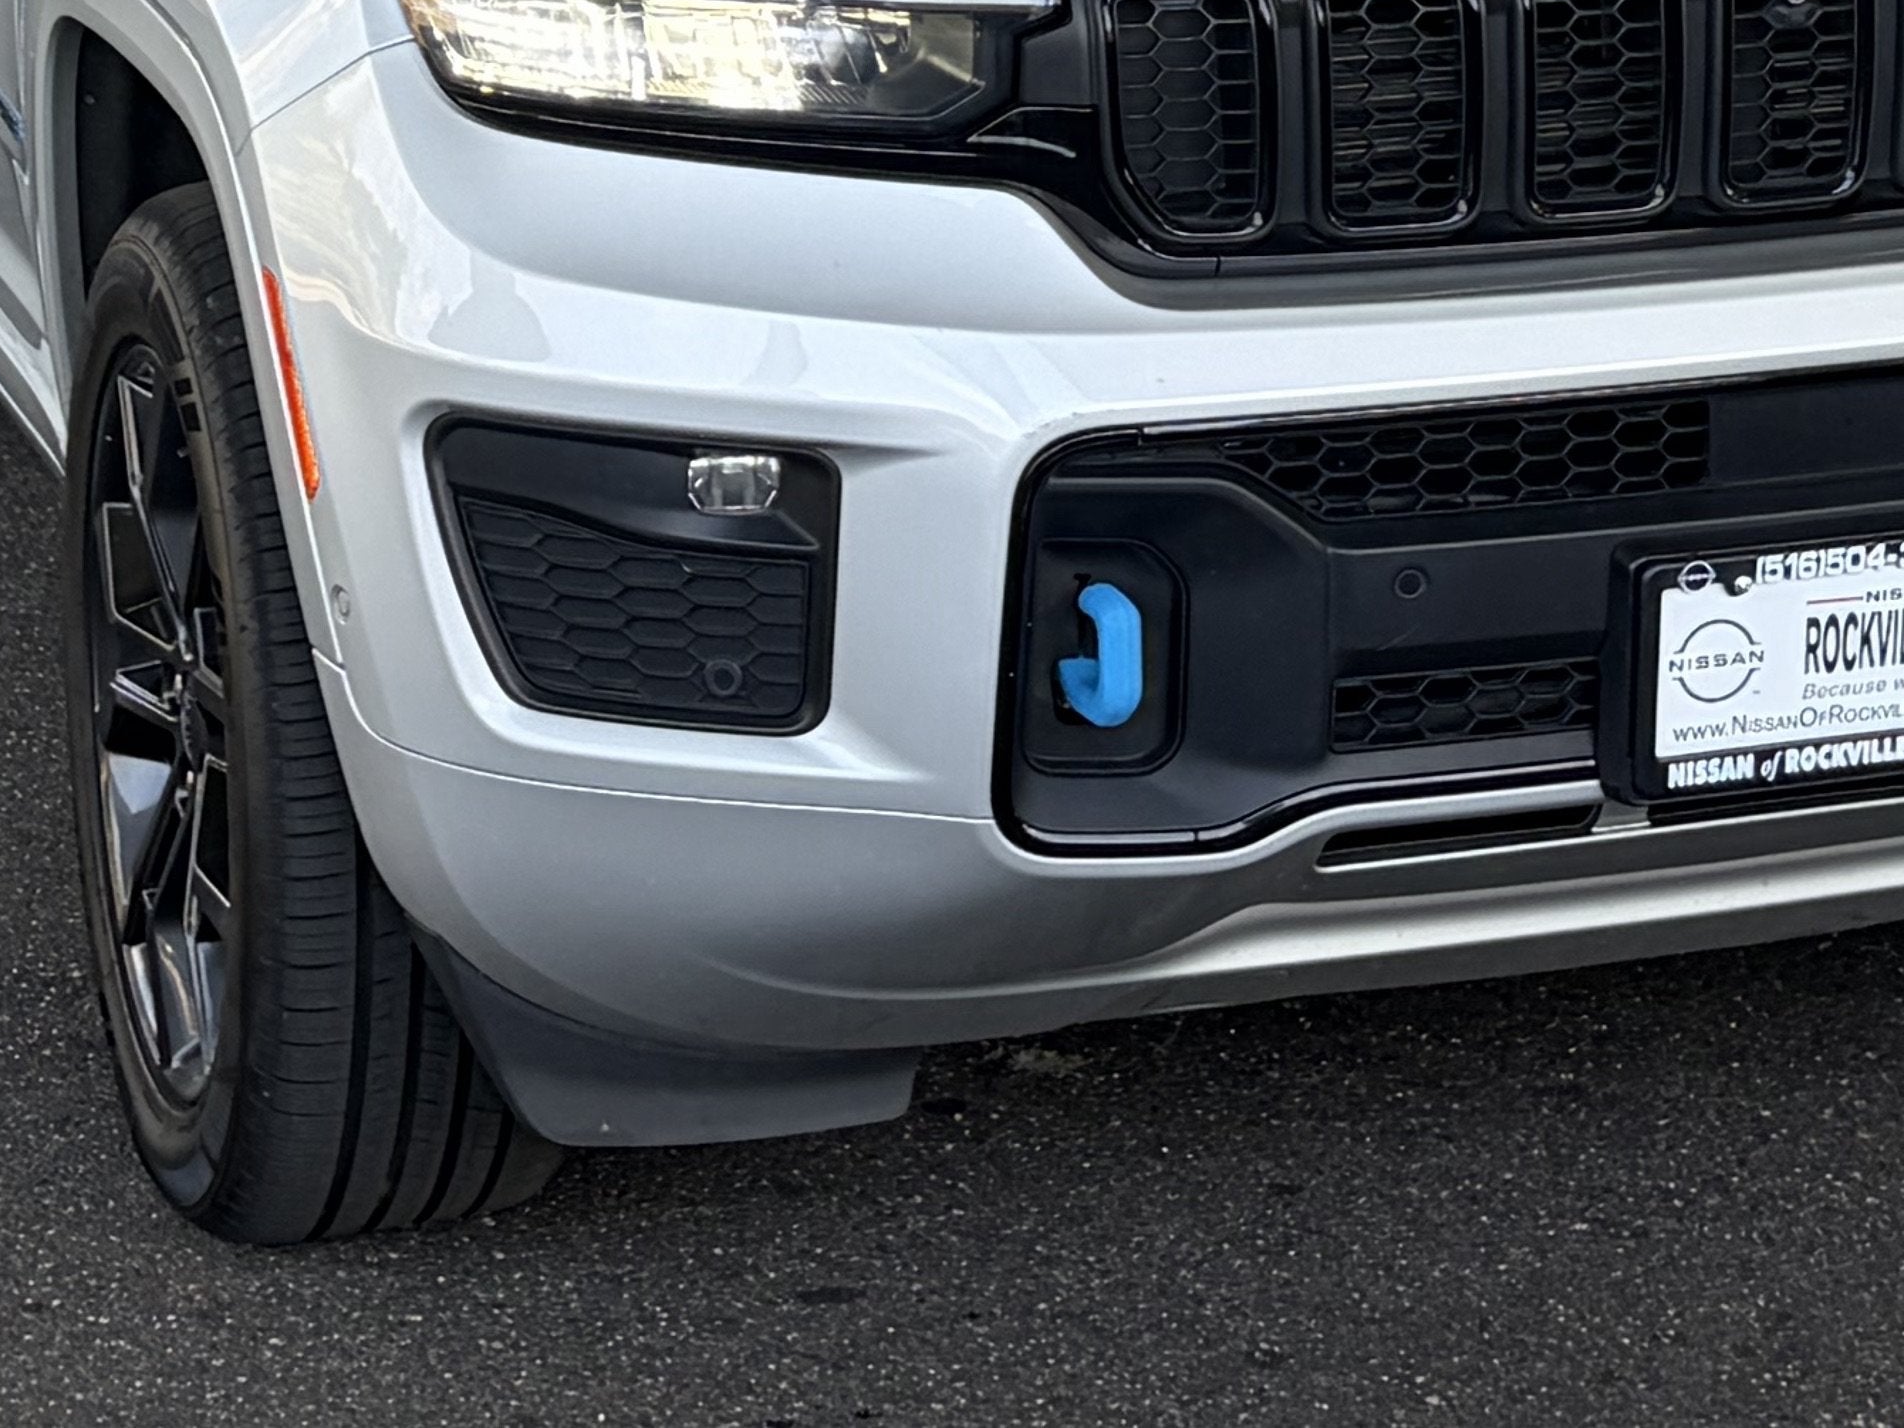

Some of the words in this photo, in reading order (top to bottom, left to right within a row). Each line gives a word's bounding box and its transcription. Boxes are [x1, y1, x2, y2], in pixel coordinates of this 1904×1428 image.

[1668, 650, 1765, 672] NISSAN
[1802, 680, 1887, 700] Because
[1667, 753, 1755, 790] NISSAN
[1760, 751, 1783, 783] of
